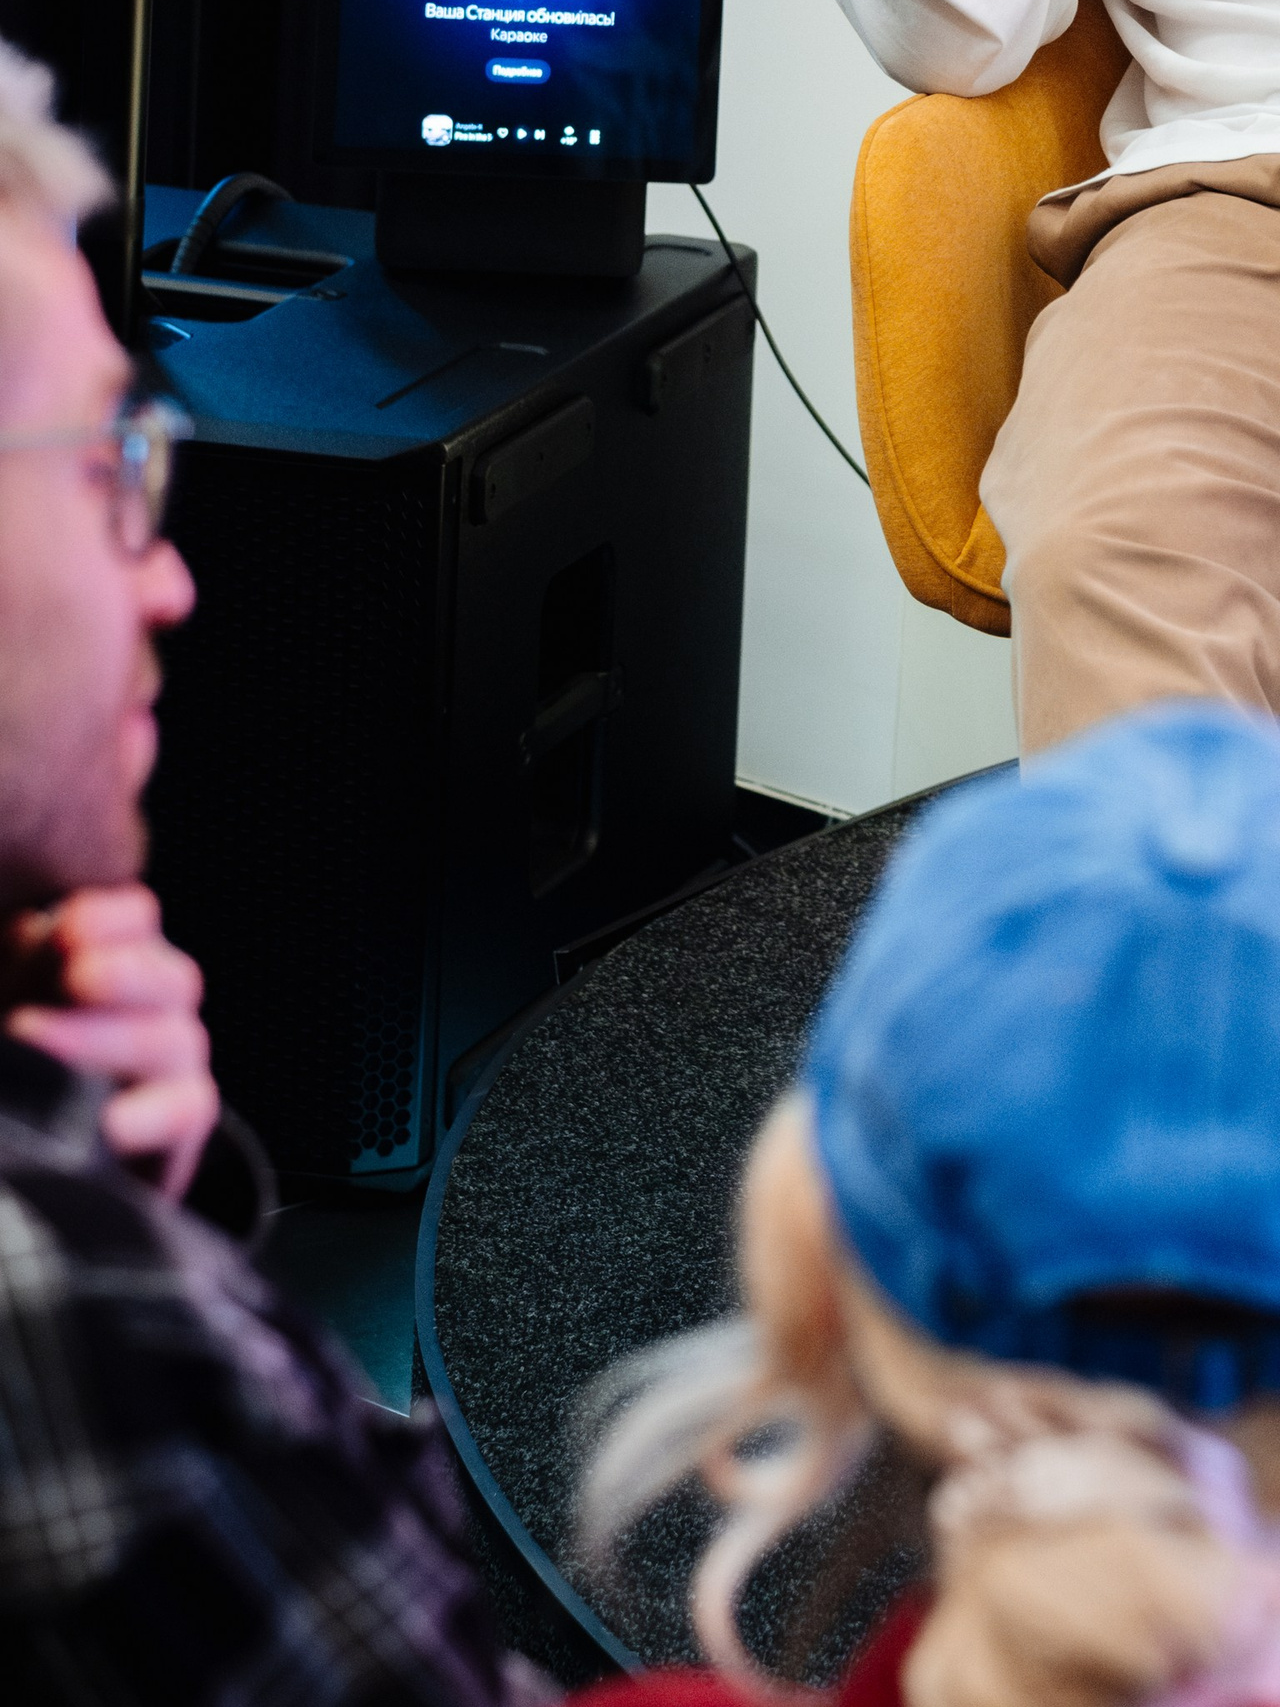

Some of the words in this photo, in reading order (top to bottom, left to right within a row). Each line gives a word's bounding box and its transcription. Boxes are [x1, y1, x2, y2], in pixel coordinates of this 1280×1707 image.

[425, 2, 464, 20] Ваша
[465, 4, 525, 24] Станция
[526, 7, 615, 26] обновилась!
[490, 28, 548, 44] Караоке
